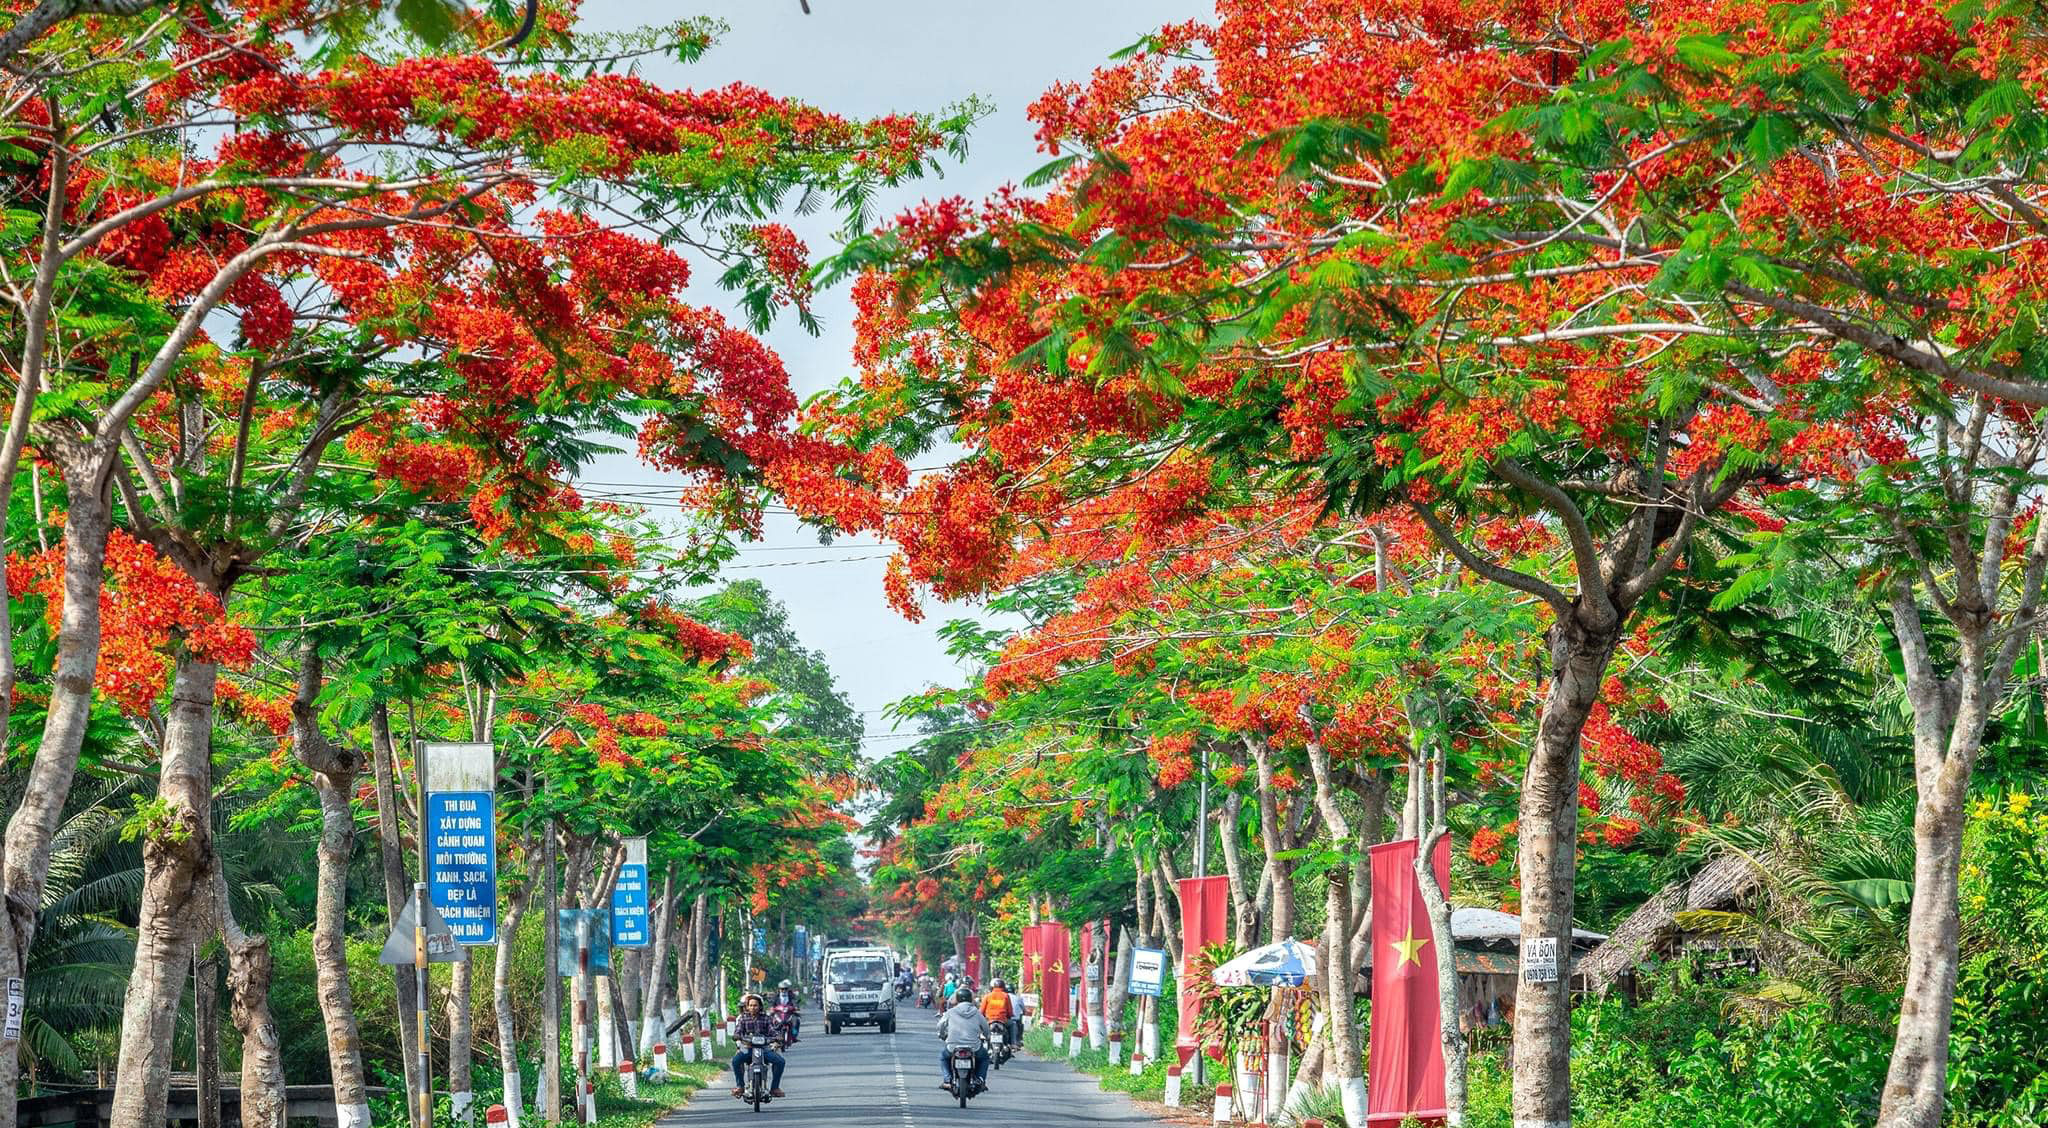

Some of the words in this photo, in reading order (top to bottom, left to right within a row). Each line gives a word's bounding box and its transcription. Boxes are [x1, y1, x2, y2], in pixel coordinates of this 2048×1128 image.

[444, 800, 458, 812] THI
[460, 800, 476, 812] ĐUA
[440, 816, 456, 830] XÂY
[459, 816, 482, 832] DỰNG
[437, 832, 460, 848] CẢNH
[462, 835, 485, 848] QUAN
[436, 851, 452, 864] MÔI
[454, 850, 487, 864] TRƯỜNG
[436, 871, 460, 884] XANH,
[464, 871, 488, 885] SẠCH,
[448, 888, 464, 903] ĐẸP
[466, 887, 477, 900] LÀ
[463, 904, 491, 920] NHIỆM
[466, 922, 484, 936] DÂN
